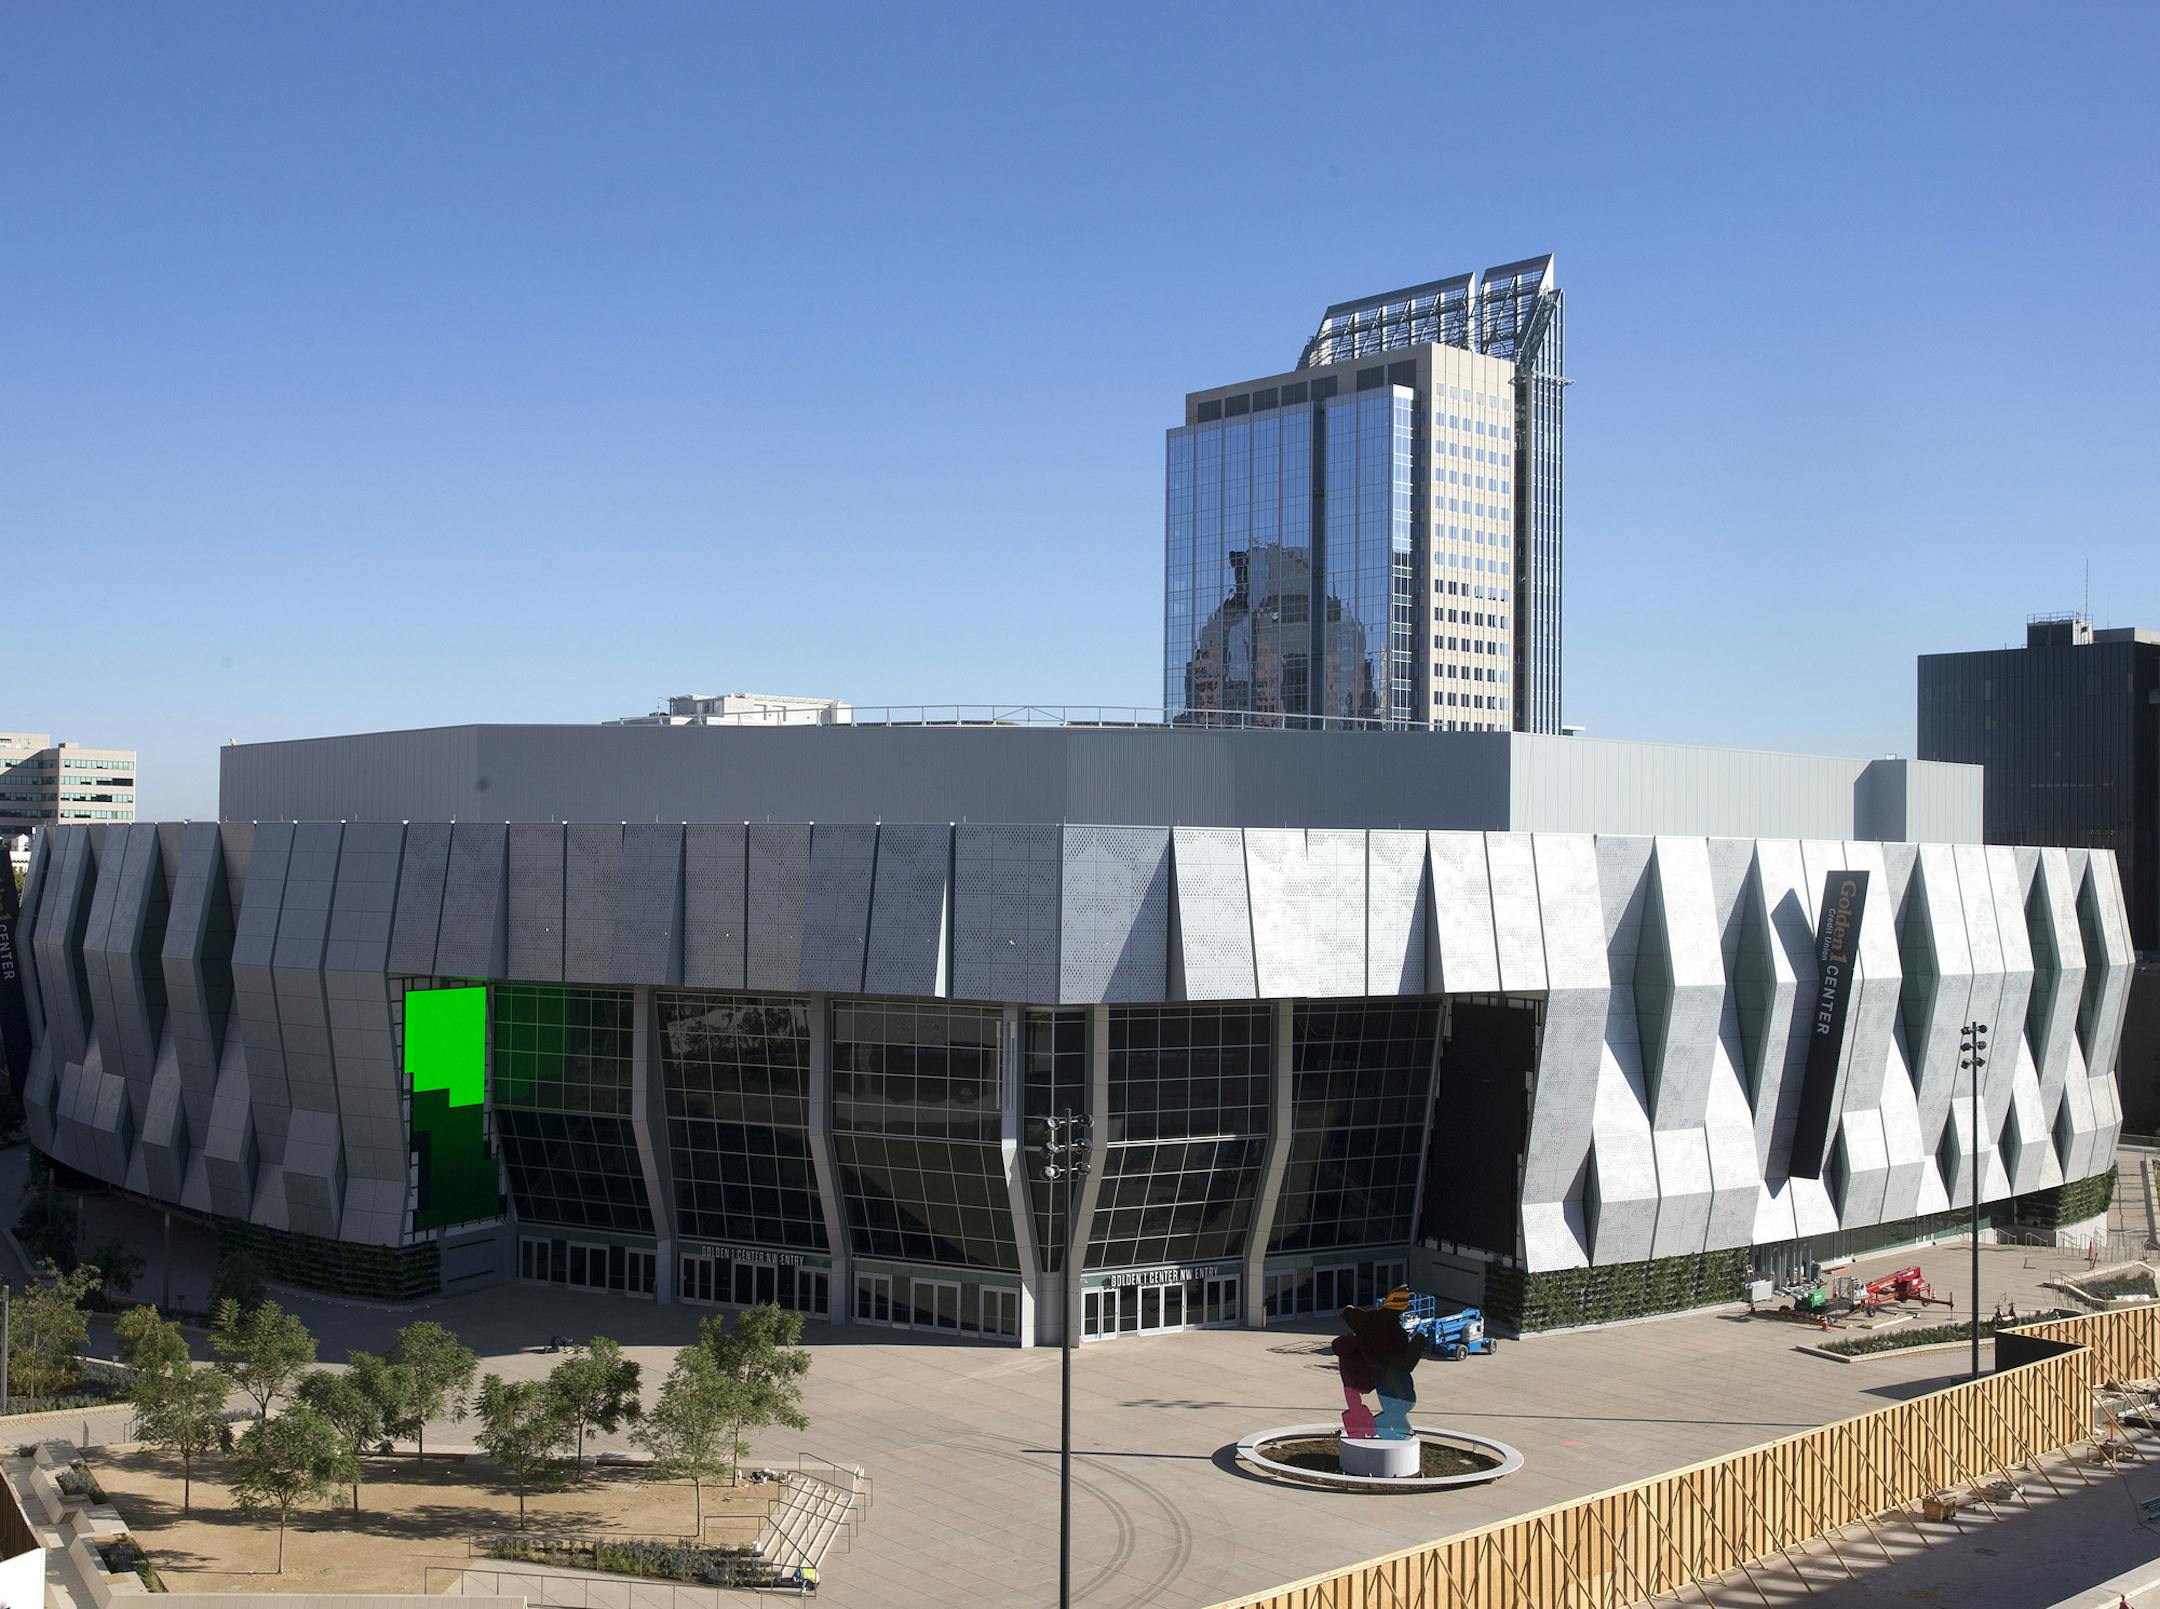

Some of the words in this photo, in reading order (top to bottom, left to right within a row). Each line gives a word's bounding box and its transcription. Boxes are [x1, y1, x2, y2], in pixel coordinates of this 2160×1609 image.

[1825, 908, 1836, 934] Credit
[1832, 880, 1857, 950] Golden
[0, 924, 15, 980] CENTER
[1821, 936, 1832, 961] Union
[1817, 965, 1839, 1034] CENTER
[702, 1245, 730, 1258] GOLDEN
[735, 1249, 764, 1263] CENTER
[766, 1252, 778, 1264] NW
[779, 1254, 805, 1266] ENTRY
[1111, 1274, 1142, 1287] GOLDEN
[1149, 1270, 1178, 1284] CENTER
[1180, 1269, 1192, 1281] NW
[1194, 1266, 1218, 1280] ENTRY
